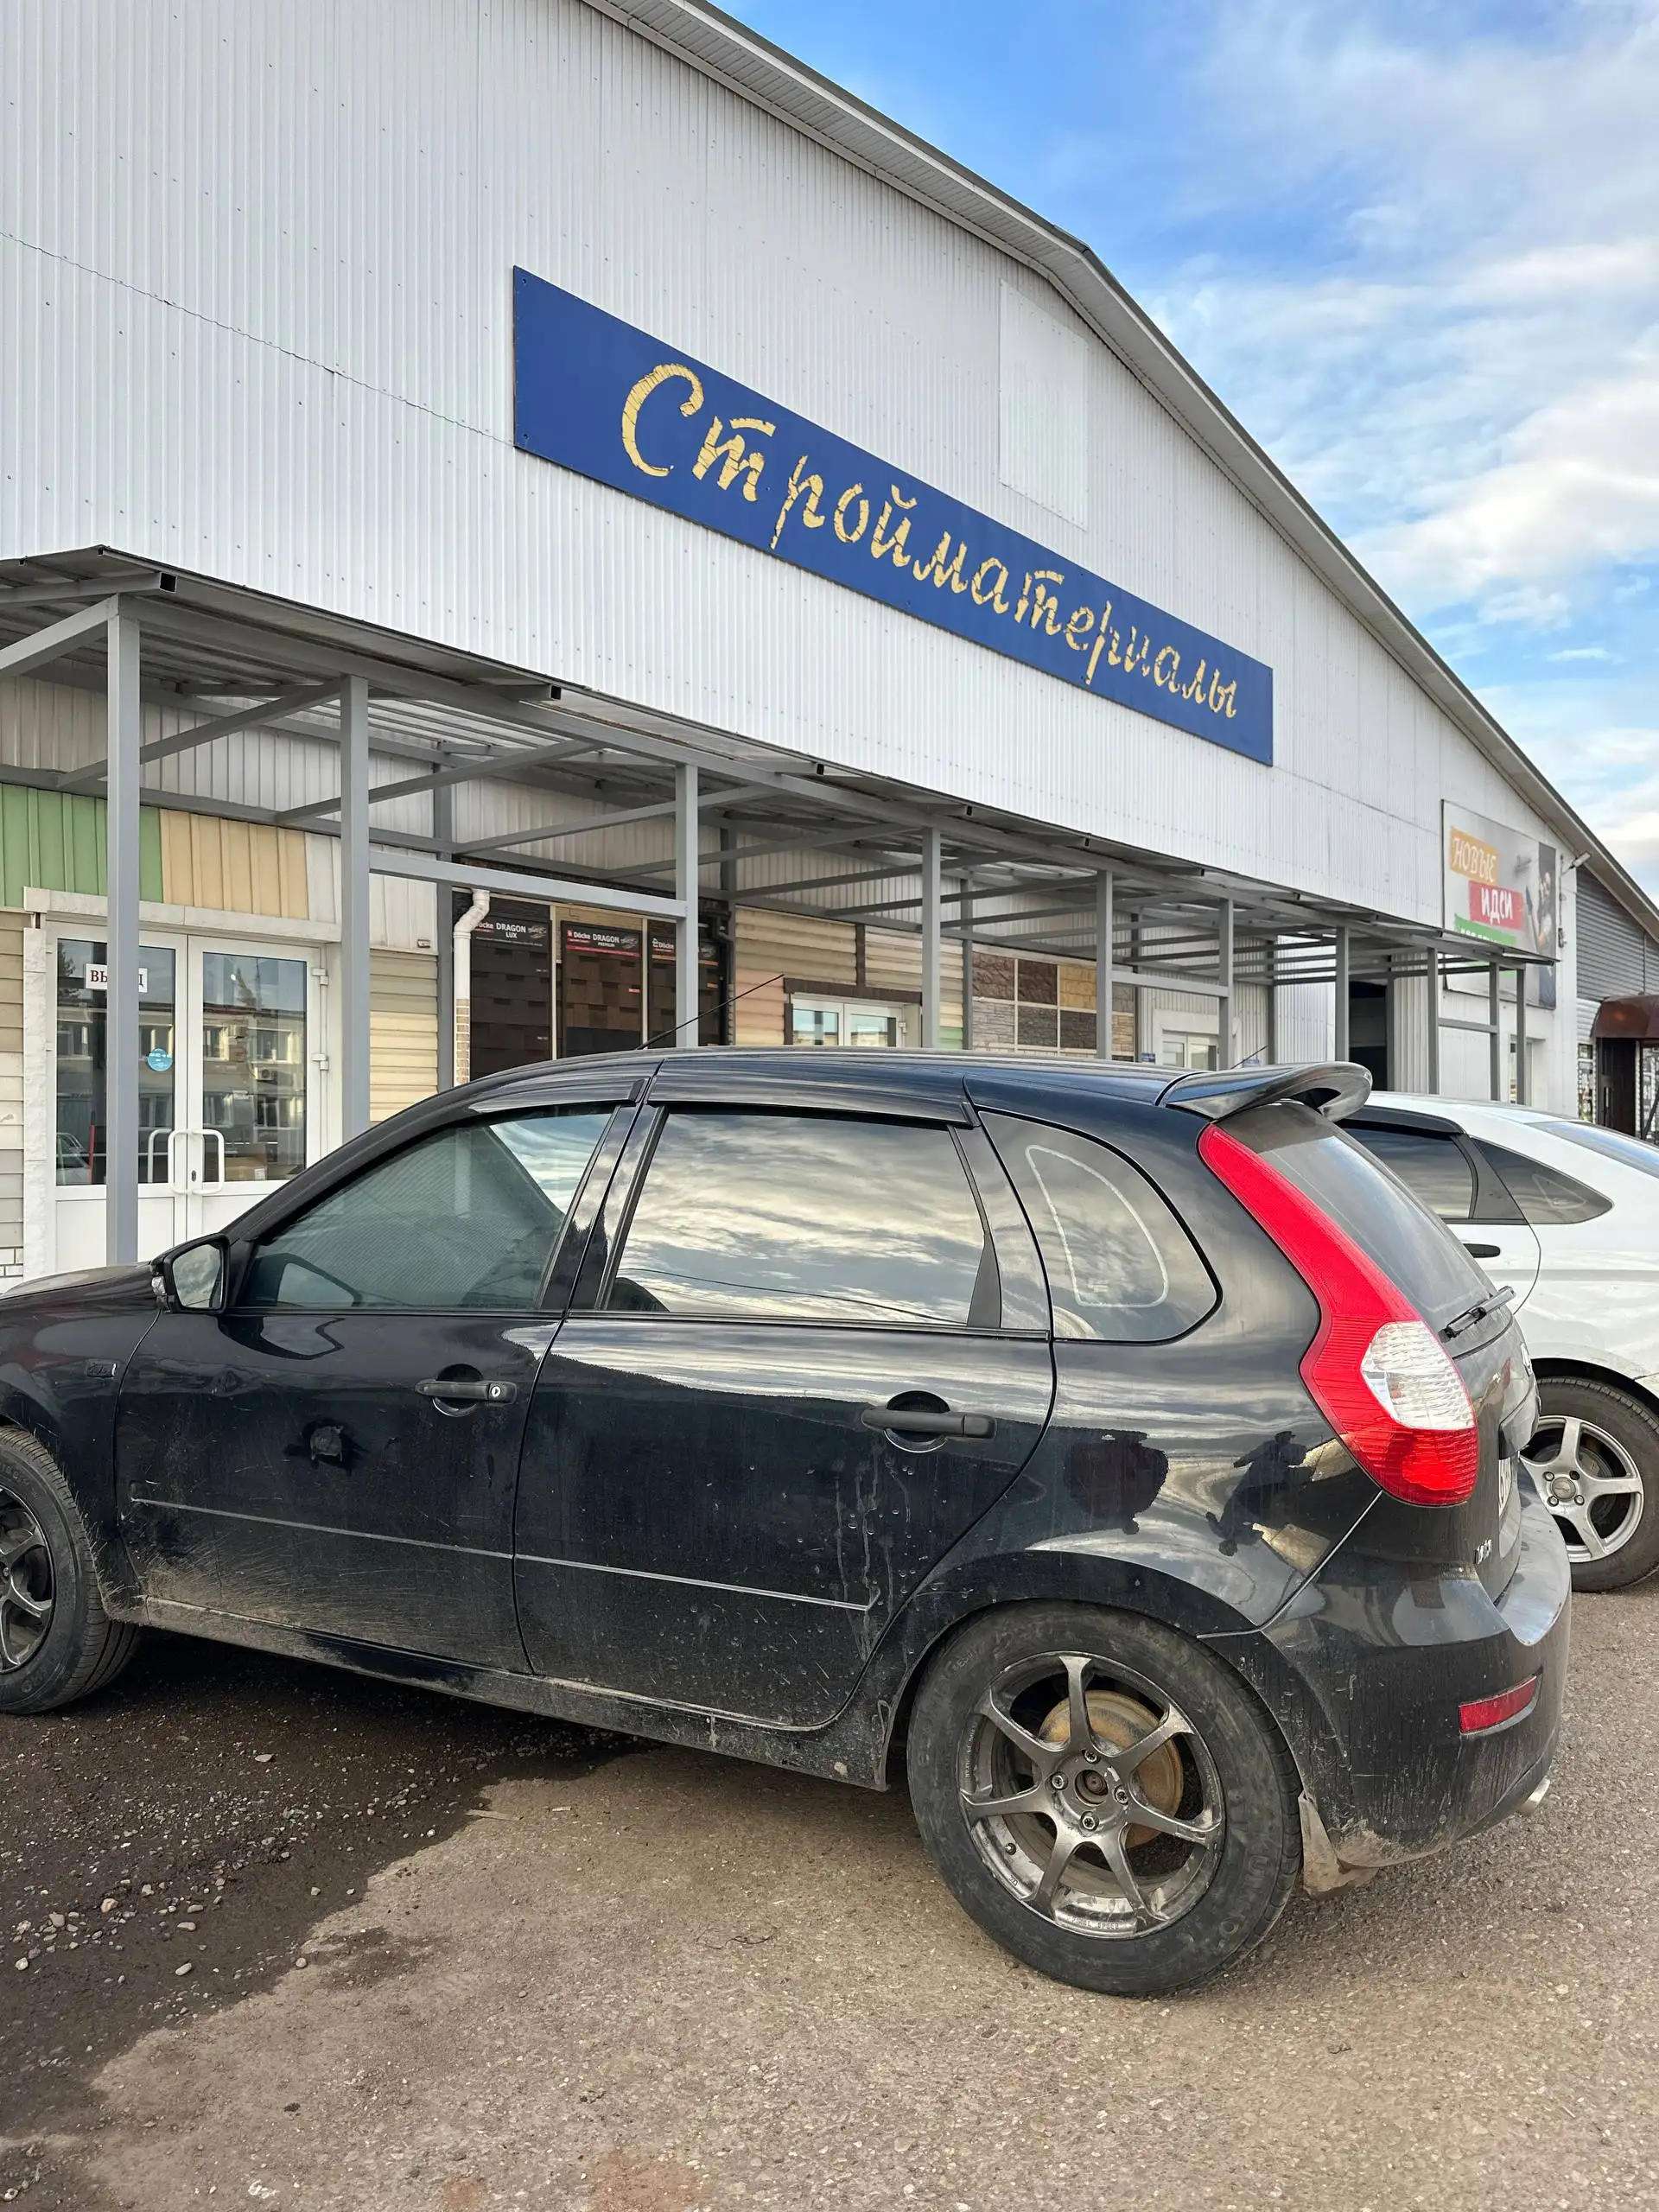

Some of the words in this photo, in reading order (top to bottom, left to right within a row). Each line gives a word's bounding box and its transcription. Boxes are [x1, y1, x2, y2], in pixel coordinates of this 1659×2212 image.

[620, 363, 1237, 719] Стройматериалы
[1452, 837, 1497, 882] НОВЫЕ
[495, 922, 526, 933] DRAGON
[593, 934, 620, 944] DRAGON
